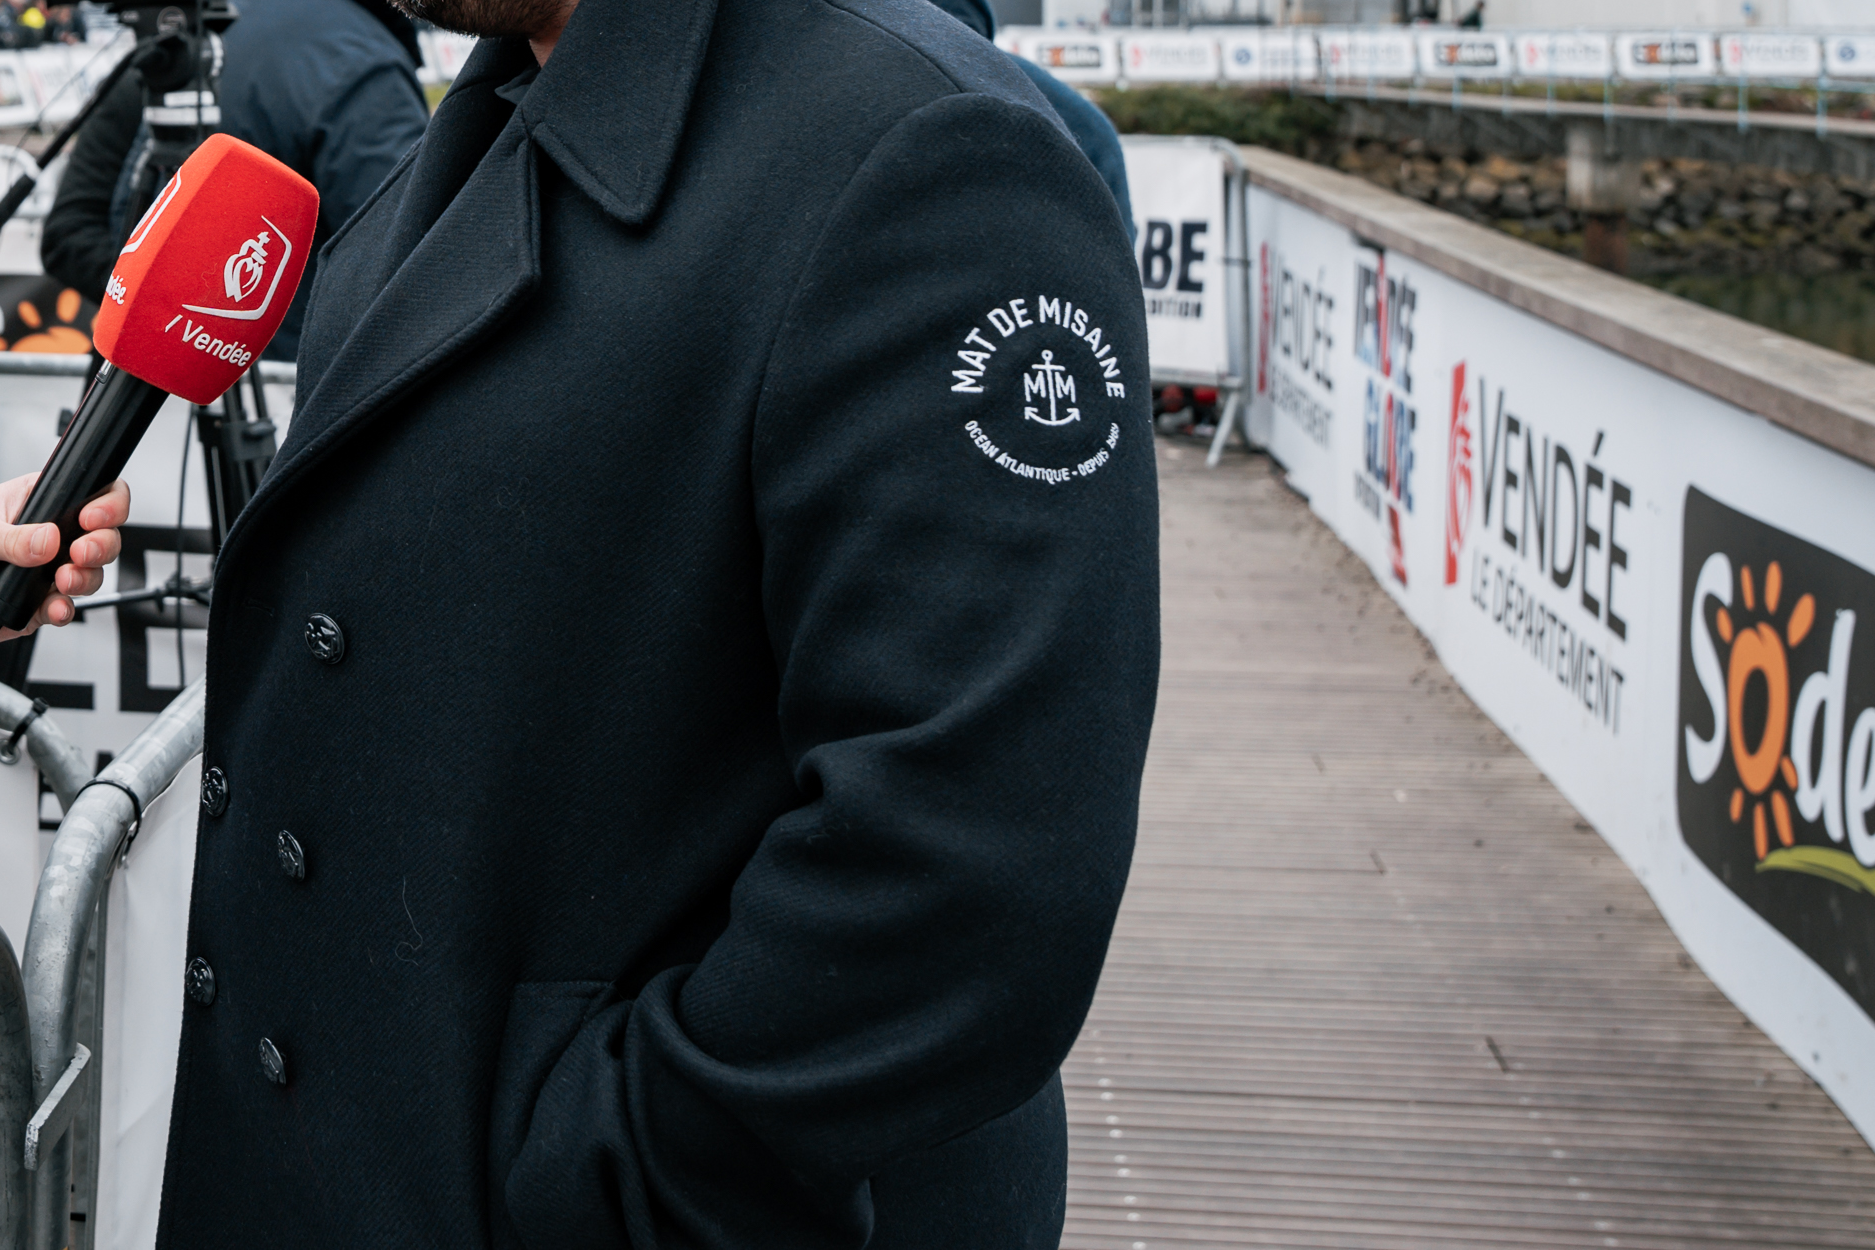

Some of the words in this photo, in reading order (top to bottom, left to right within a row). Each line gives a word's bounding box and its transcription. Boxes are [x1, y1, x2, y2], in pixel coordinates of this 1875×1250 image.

[182, 319, 252, 367] Vendée
[951, 327, 997, 393] MAT
[986, 298, 1034, 338] DE
[1039, 294, 1125, 399] MISAINE
[964, 419, 1000, 458] OCEAN
[994, 452, 1071, 485] ATLANTIQUE
[1477, 376, 1632, 643] VENDÉE
[1491, 564, 1625, 736] DÉPARTEMENT
